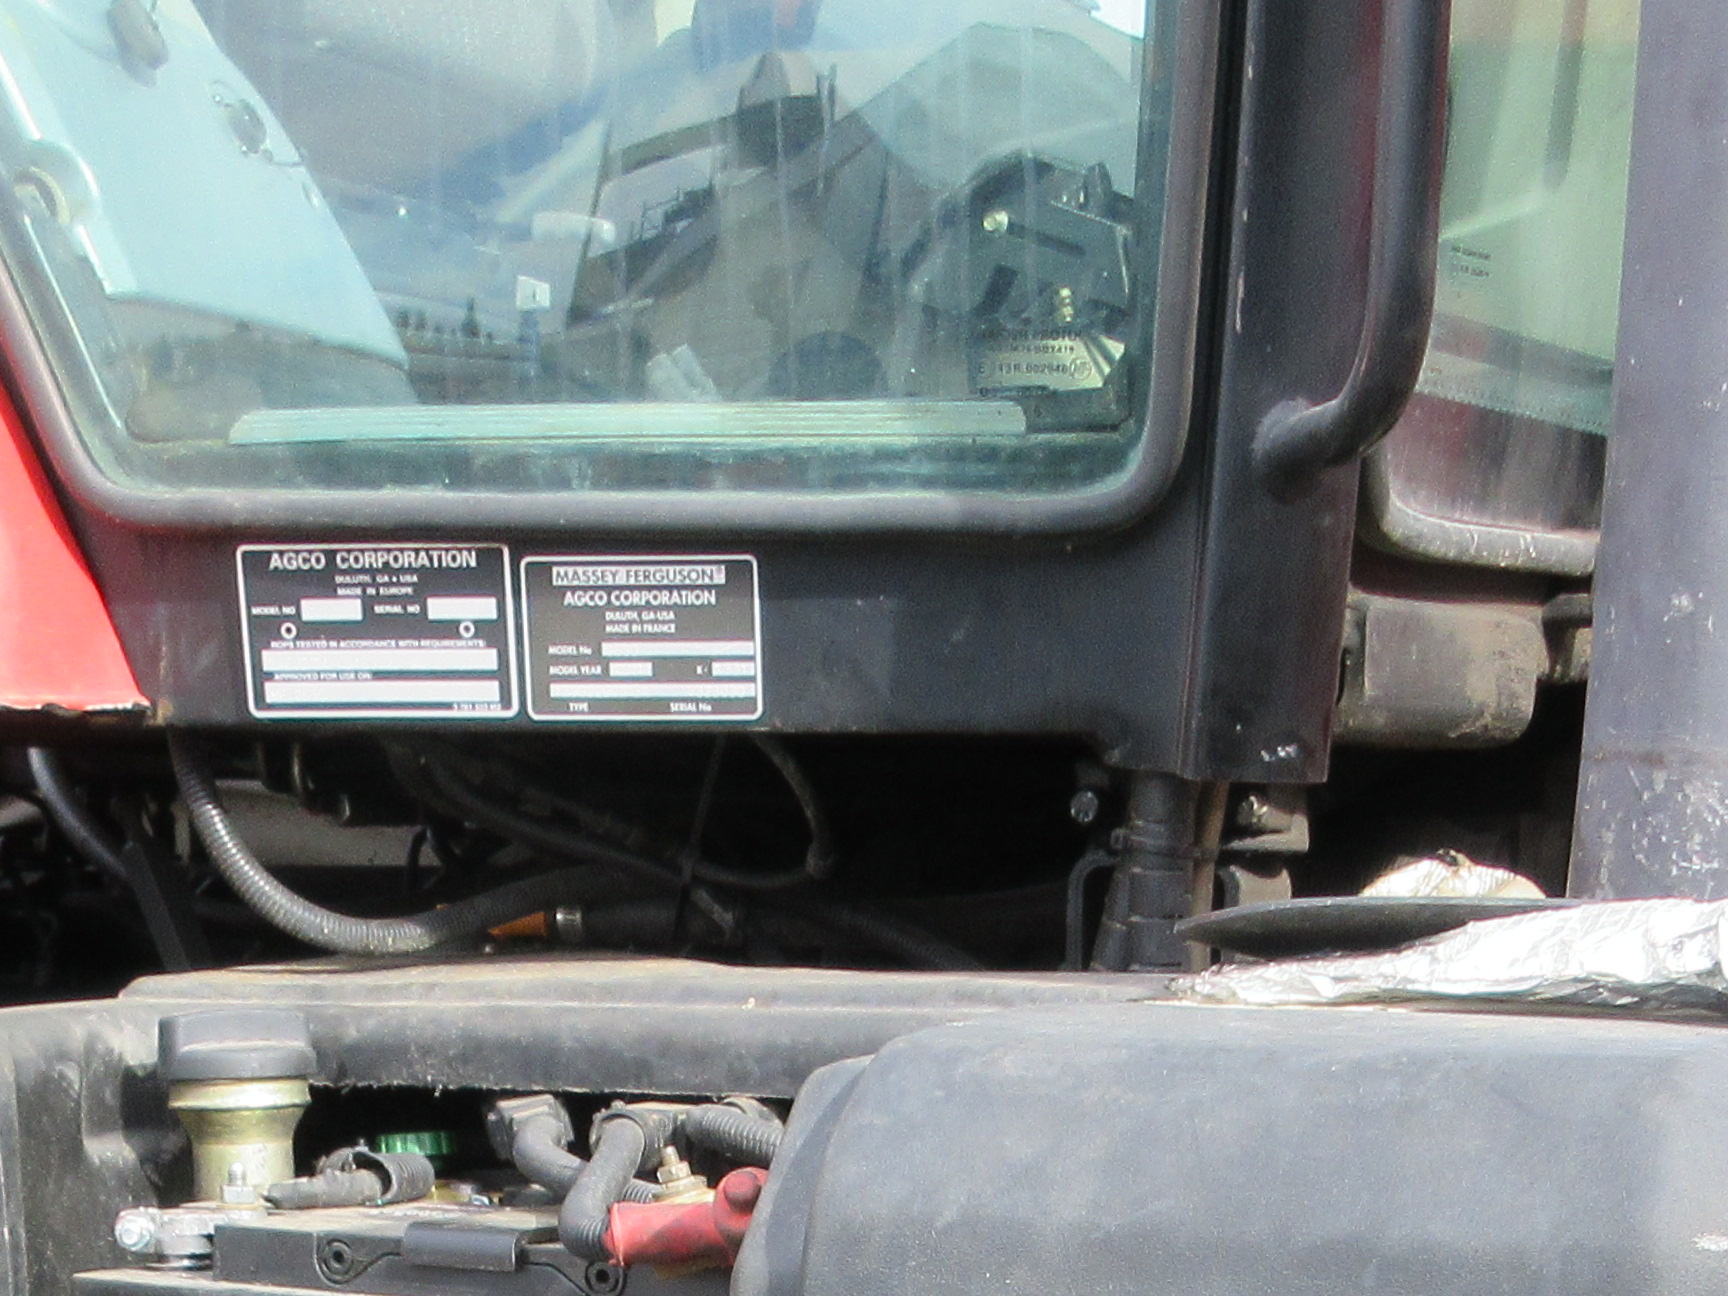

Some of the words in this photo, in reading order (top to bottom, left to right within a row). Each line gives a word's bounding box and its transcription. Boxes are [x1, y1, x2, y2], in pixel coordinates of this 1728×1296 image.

[269, 552, 326, 571] AGCO
[335, 550, 477, 570] CORPORATION
[555, 568, 618, 584] MASSEY
[625, 567, 715, 584] FERGUSON
[336, 586, 363, 596] MADE
[365, 586, 377, 596] IN
[563, 590, 608, 607] AGCO
[610, 589, 716, 607] CORPORATION
[251, 605, 281, 616] MODEL
[605, 622, 630, 634] MADE
[632, 622, 642, 633] IN
[643, 622, 676, 633] FRANCE
[548, 644, 577, 655] MODEL
[549, 664, 578, 675] MODEL
[580, 664, 602, 675] YEAR
[568, 702, 589, 712] TYPE
[669, 701, 698, 712] SERIAL
